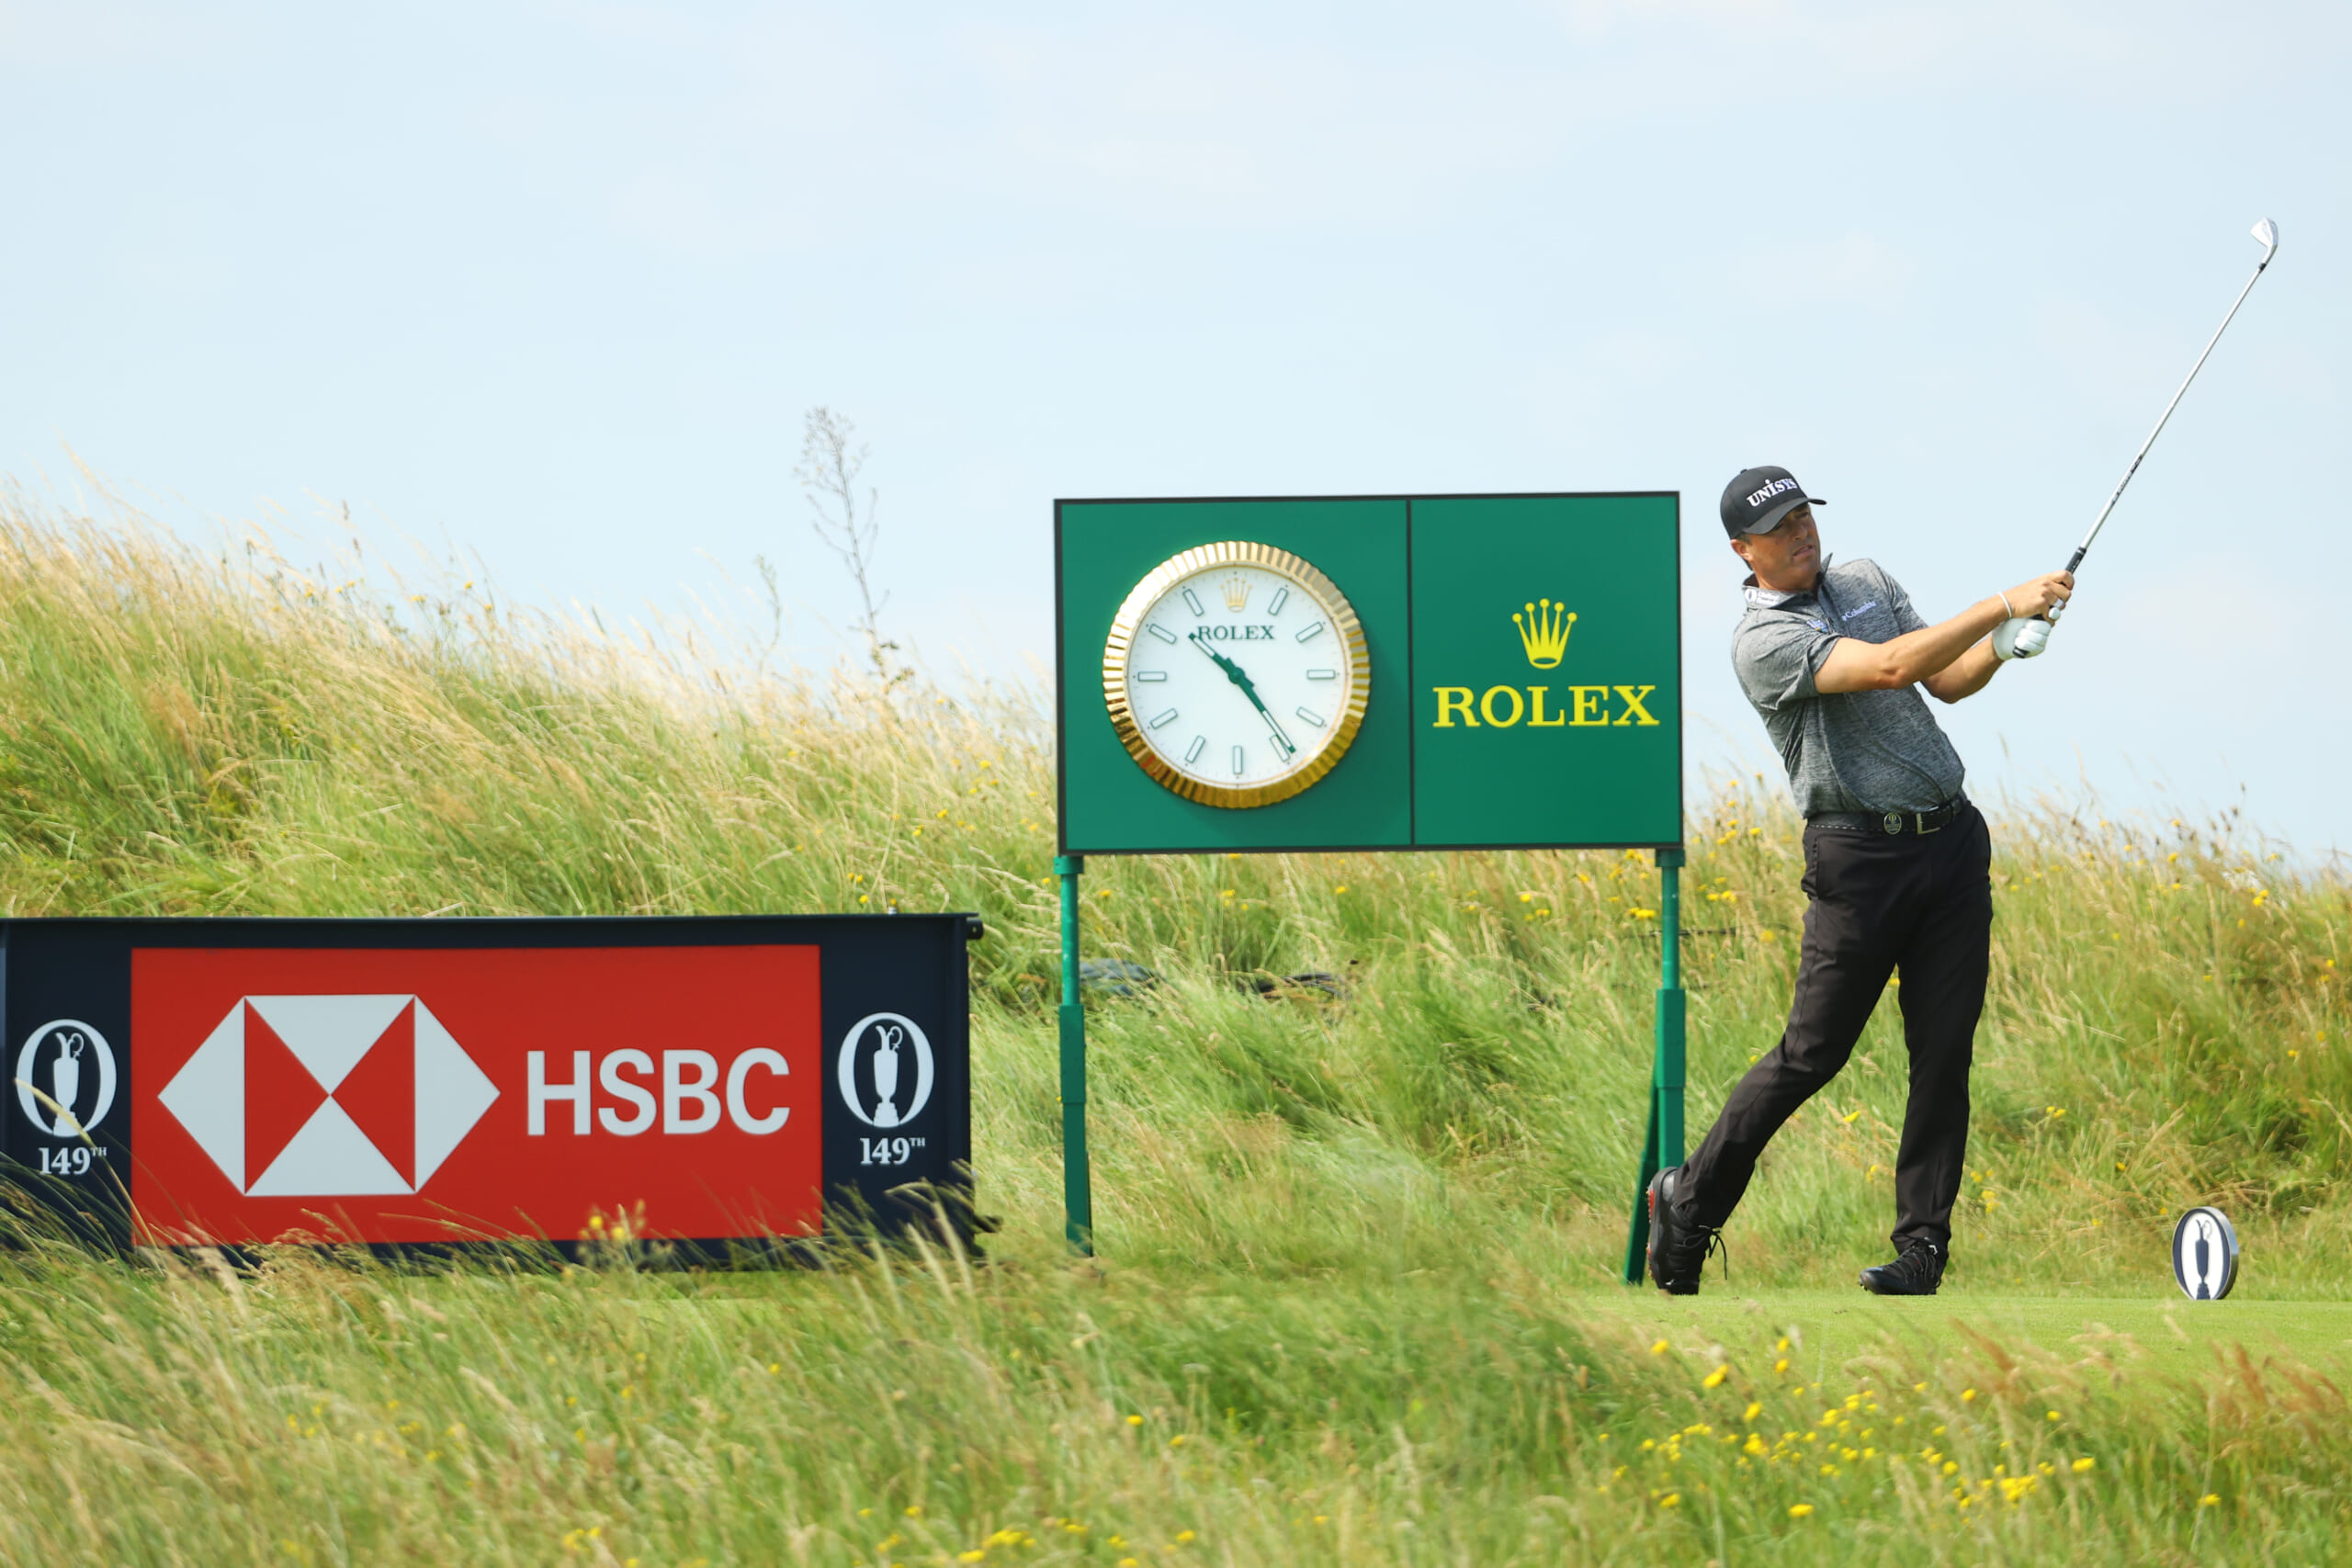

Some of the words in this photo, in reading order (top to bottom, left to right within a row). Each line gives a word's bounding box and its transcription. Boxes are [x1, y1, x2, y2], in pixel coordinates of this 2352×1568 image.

[1197, 625, 1275, 641] ROLEX
[1432, 684, 1660, 728] ROLEX
[526, 1047, 791, 1137] HSBC
